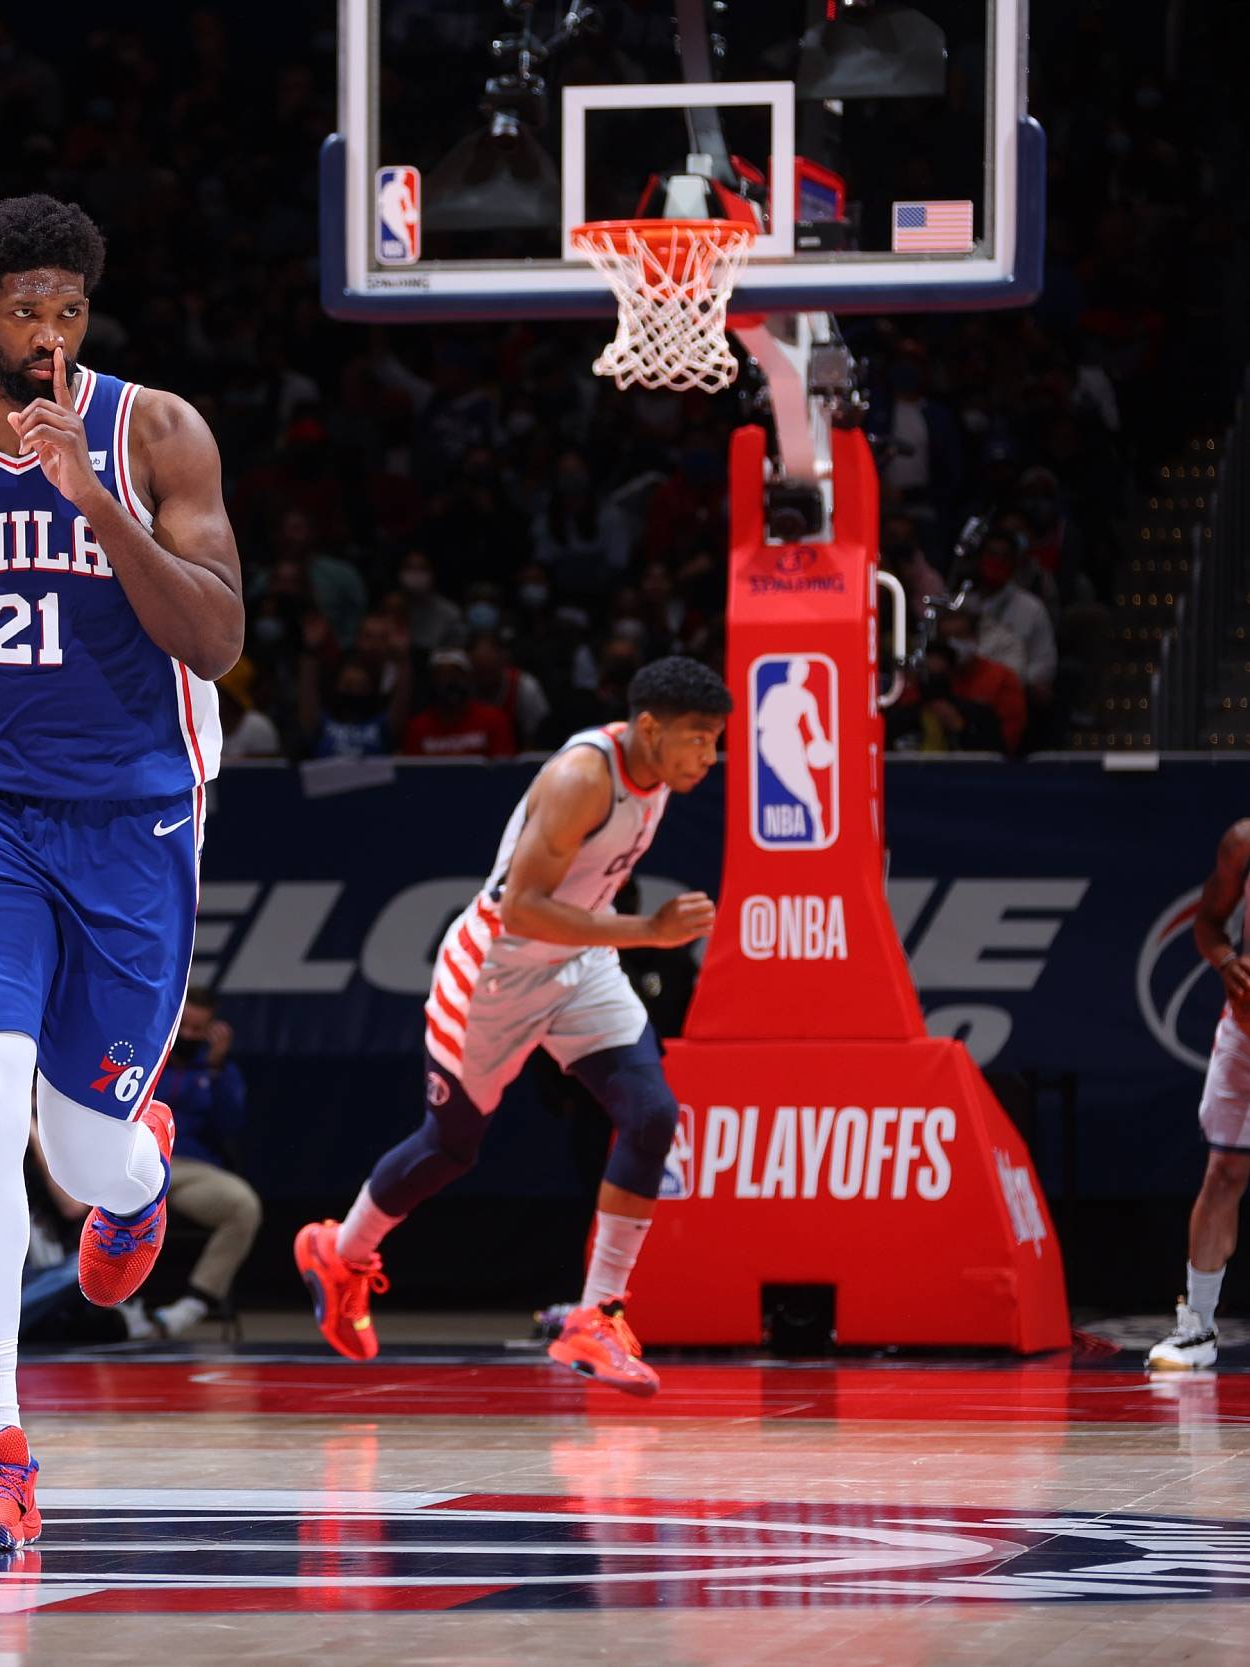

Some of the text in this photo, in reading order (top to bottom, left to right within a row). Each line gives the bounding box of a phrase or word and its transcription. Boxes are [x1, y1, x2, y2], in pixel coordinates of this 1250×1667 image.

[763, 804, 807, 837] NBA
[740, 894, 848, 960] @NBA
[698, 1105, 956, 1201] PLAYOFFS
